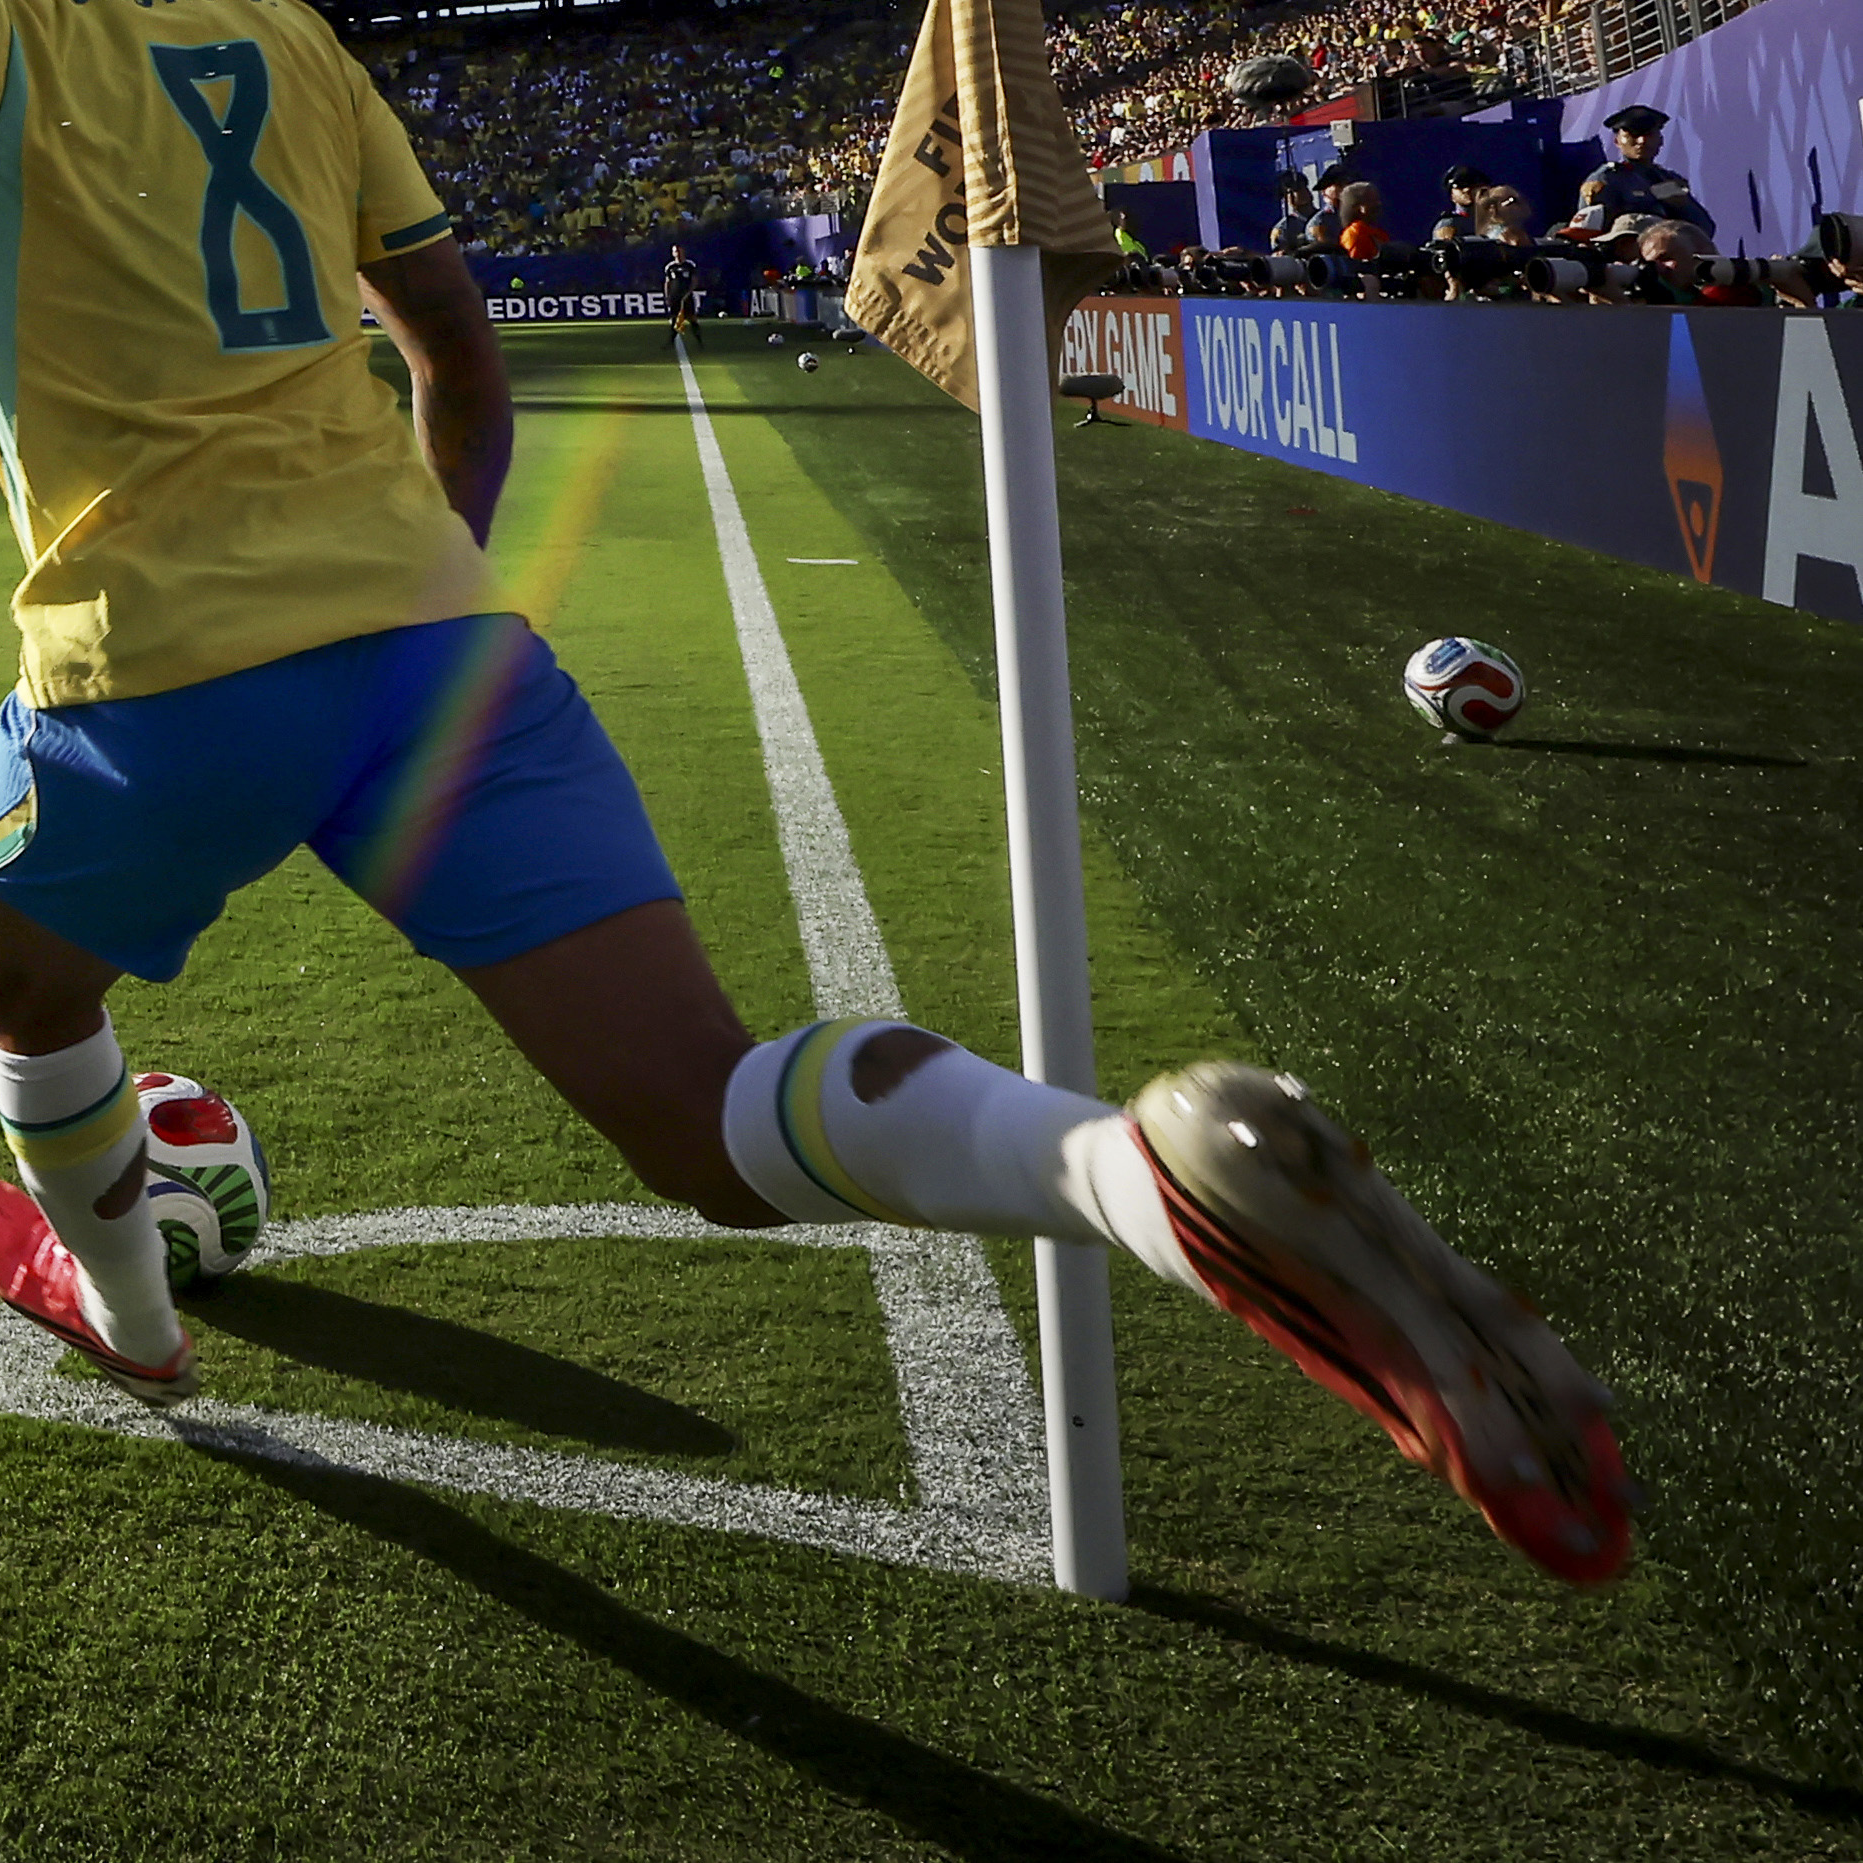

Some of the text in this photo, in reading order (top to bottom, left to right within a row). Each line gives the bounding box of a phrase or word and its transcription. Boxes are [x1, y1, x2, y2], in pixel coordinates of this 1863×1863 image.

[149, 39, 337, 354] 8
[901, 182, 968, 286] WO
[487, 289, 707, 320] EDICTSTRET
[1105, 308, 1177, 417] GAME
[1194, 314, 1358, 464] YOUR CALL
